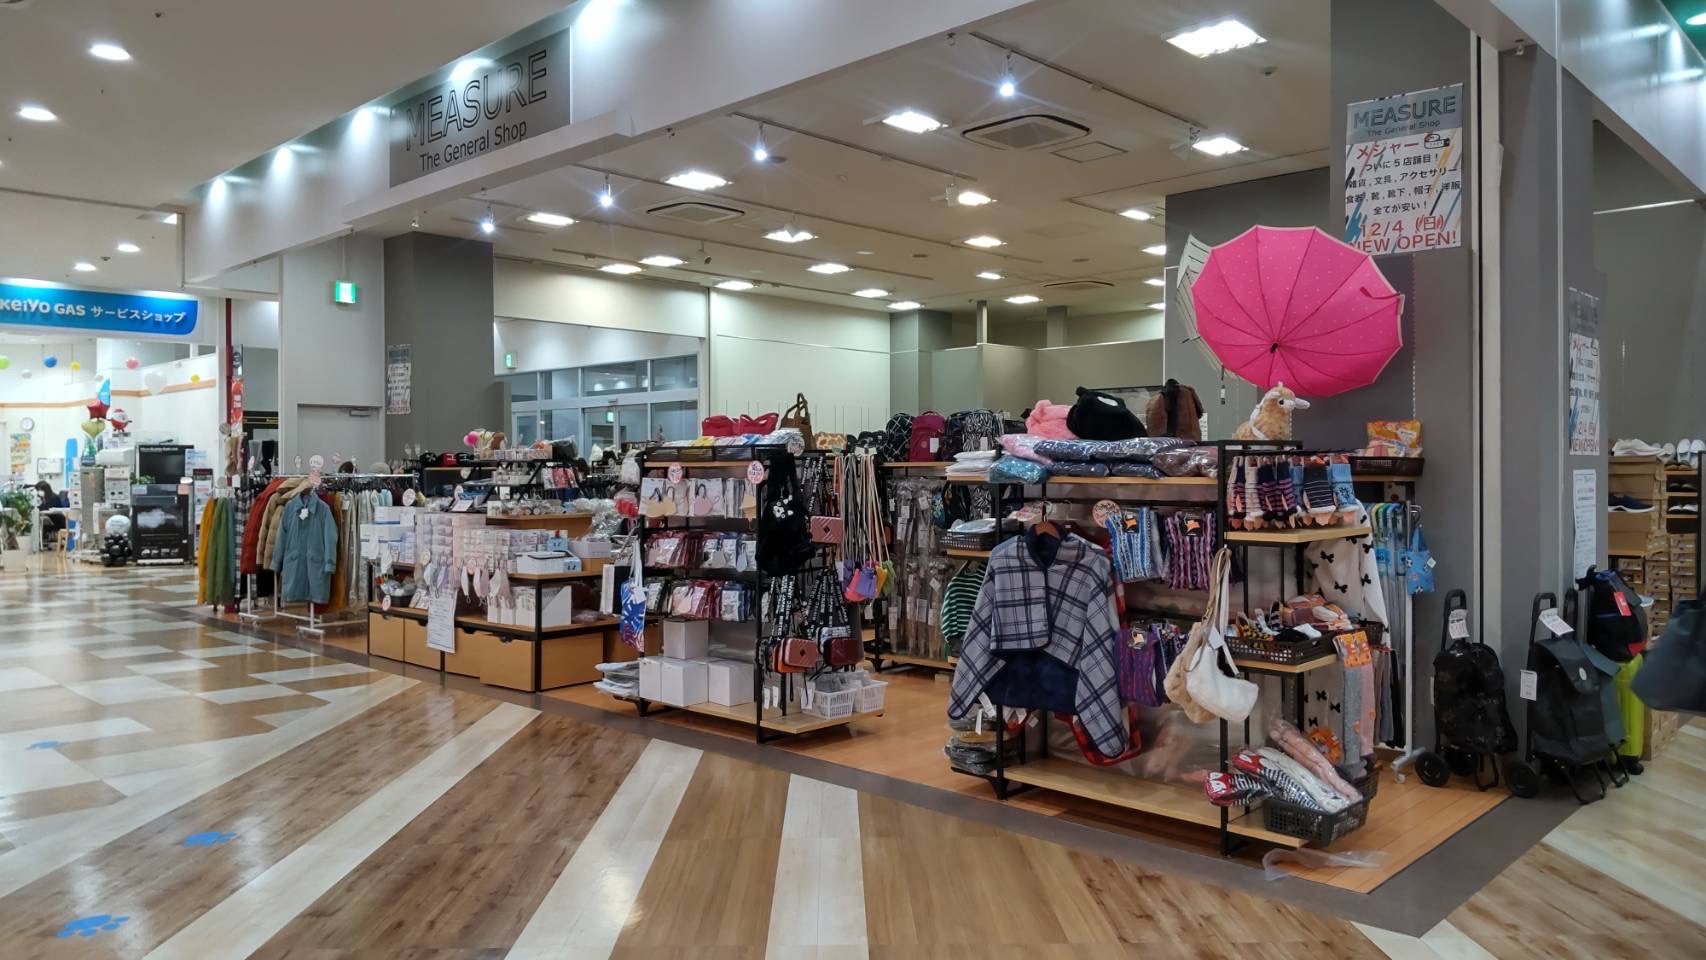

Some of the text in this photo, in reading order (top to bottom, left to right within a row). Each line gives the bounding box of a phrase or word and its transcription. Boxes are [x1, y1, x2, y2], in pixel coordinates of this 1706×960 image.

[406, 49, 547, 152] MEASURE
[1354, 96, 1457, 128] MEASURE
[1368, 120, 1441, 137] The General Shop
[420, 120, 527, 172] The General Shop
[1357, 143, 1419, 160] メジャー
[1360, 219, 1405, 237] 12/4
[1397, 230, 1457, 250] OPEN!
[54, 303, 86, 316] GAS
[90, 304, 187, 323] サービスショップ
